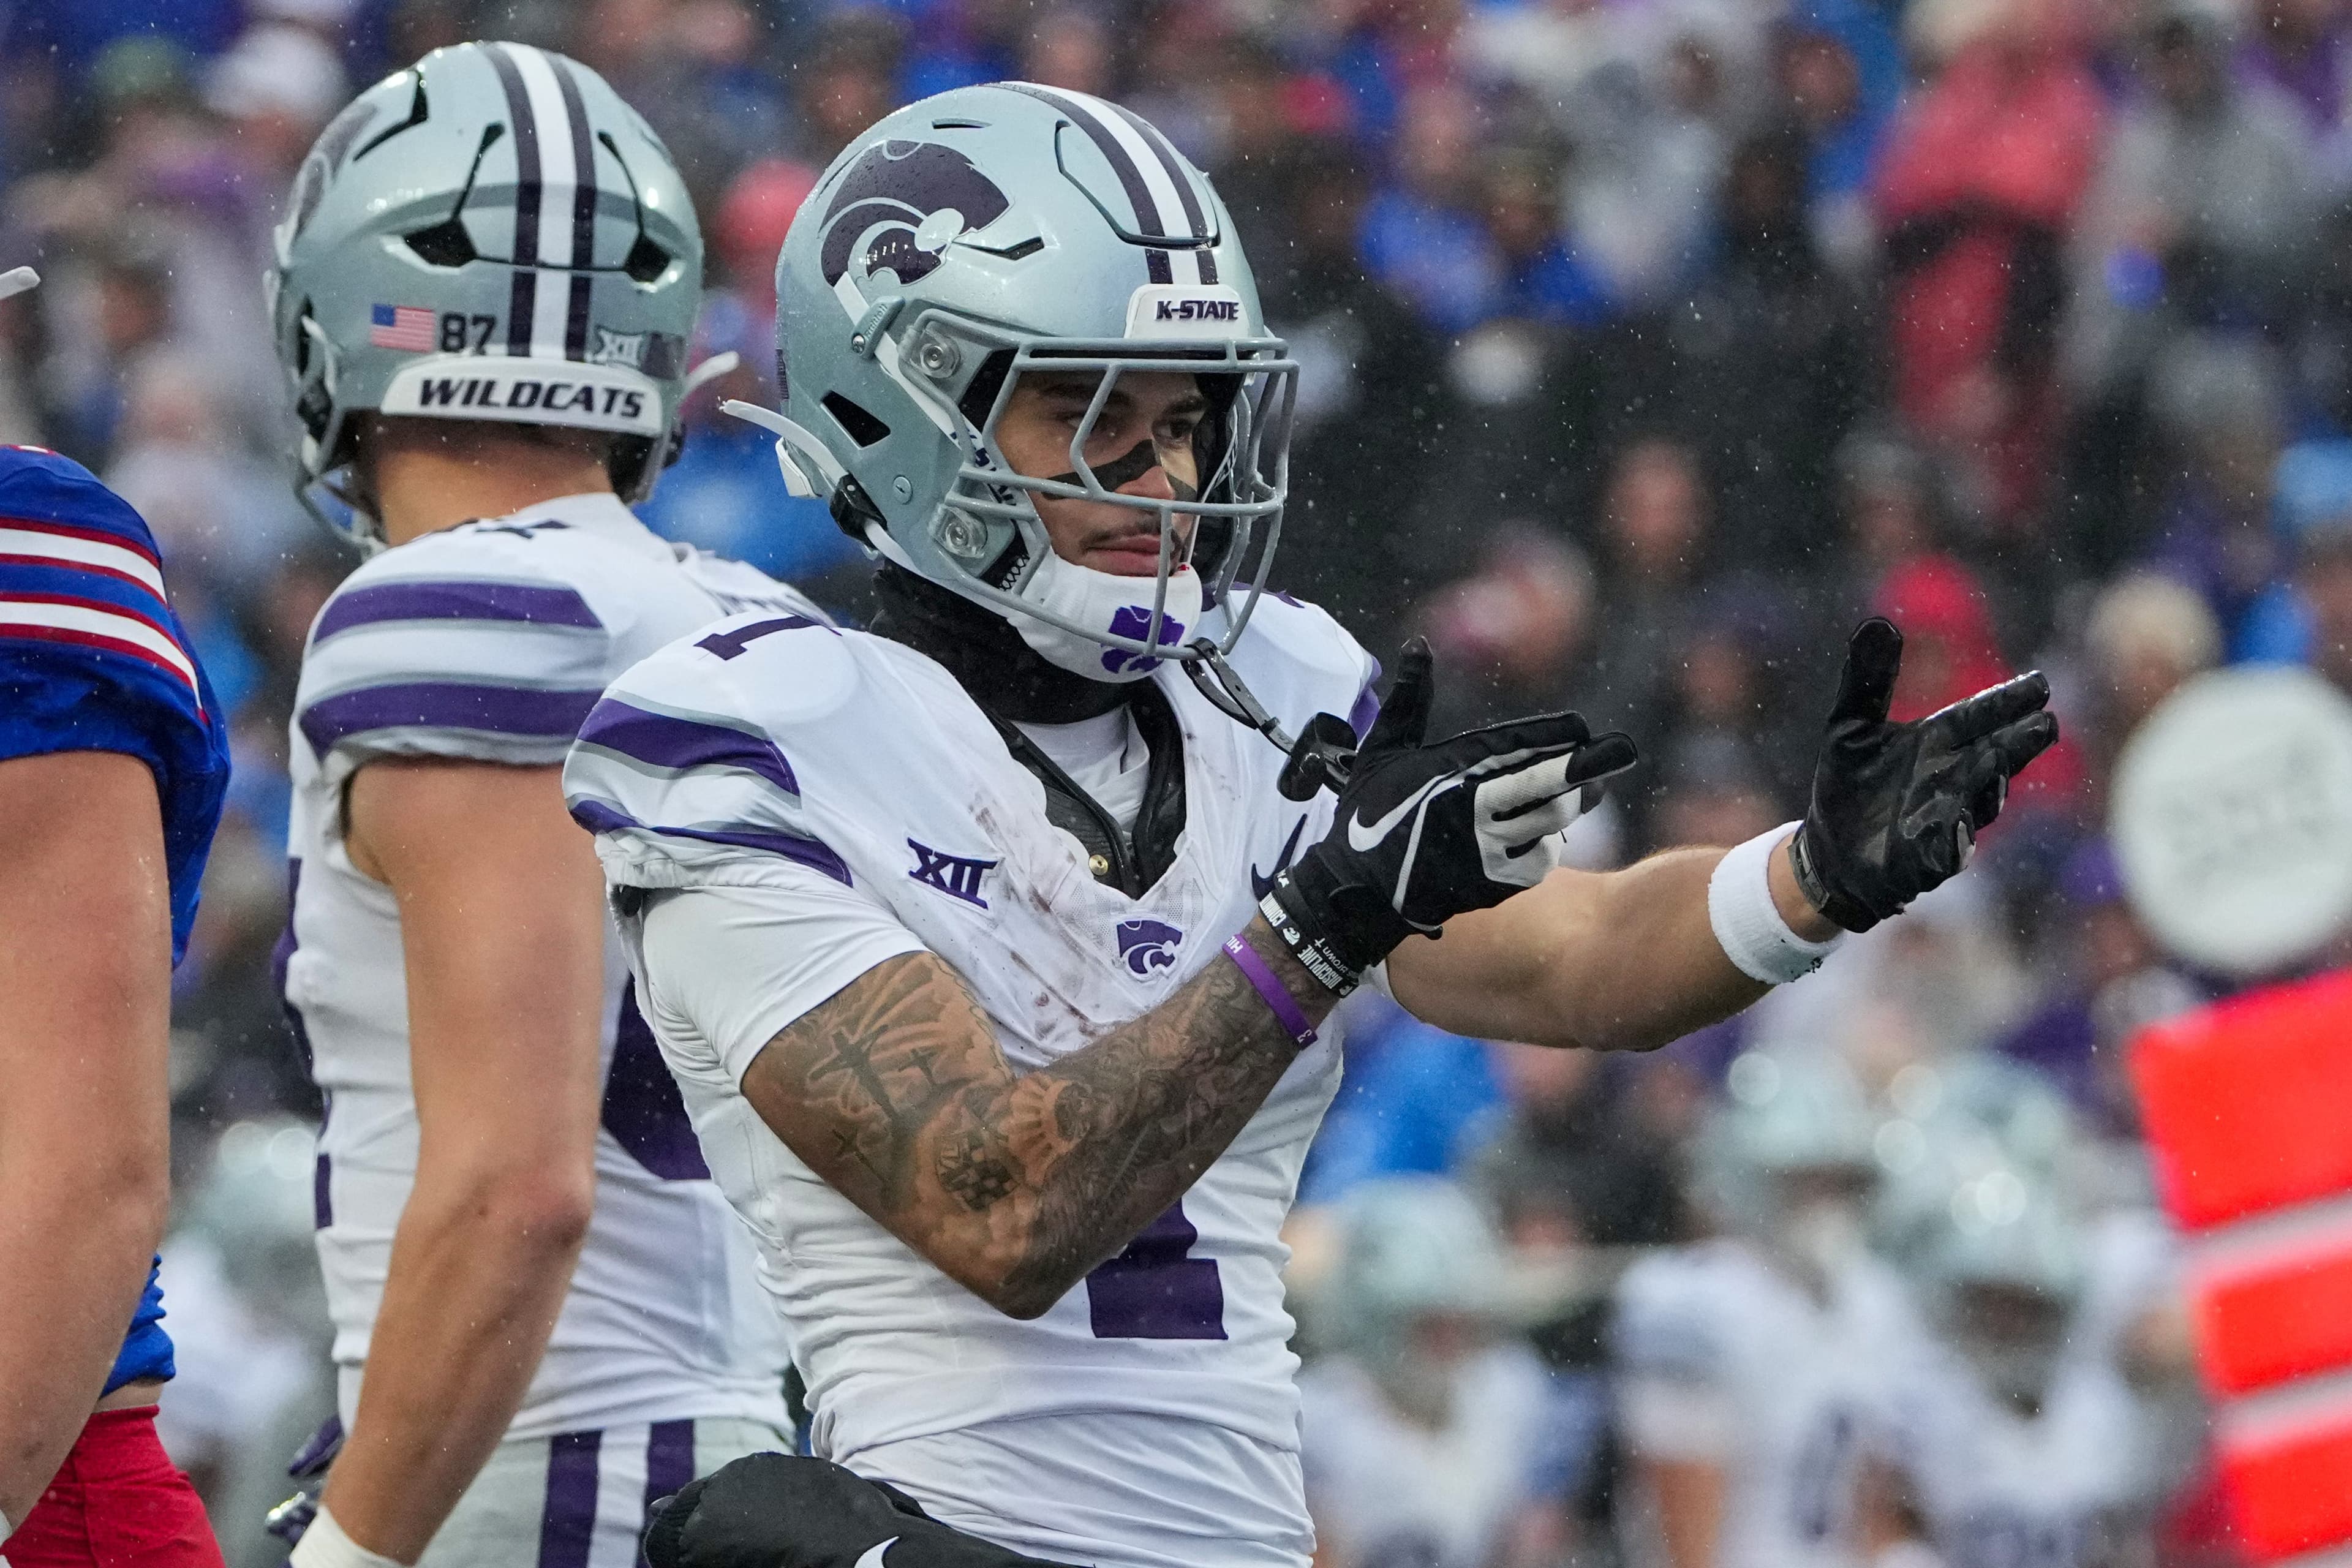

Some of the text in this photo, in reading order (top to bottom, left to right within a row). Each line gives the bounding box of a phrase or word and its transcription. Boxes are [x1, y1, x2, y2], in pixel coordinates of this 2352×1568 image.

[1156, 300, 1239, 320] K-STATE
[441, 312, 496, 355] 87
[420, 378, 645, 418] WILDCATS
[907, 837, 998, 910] XII
[1297, 944, 1343, 989] DISCIPLINE
